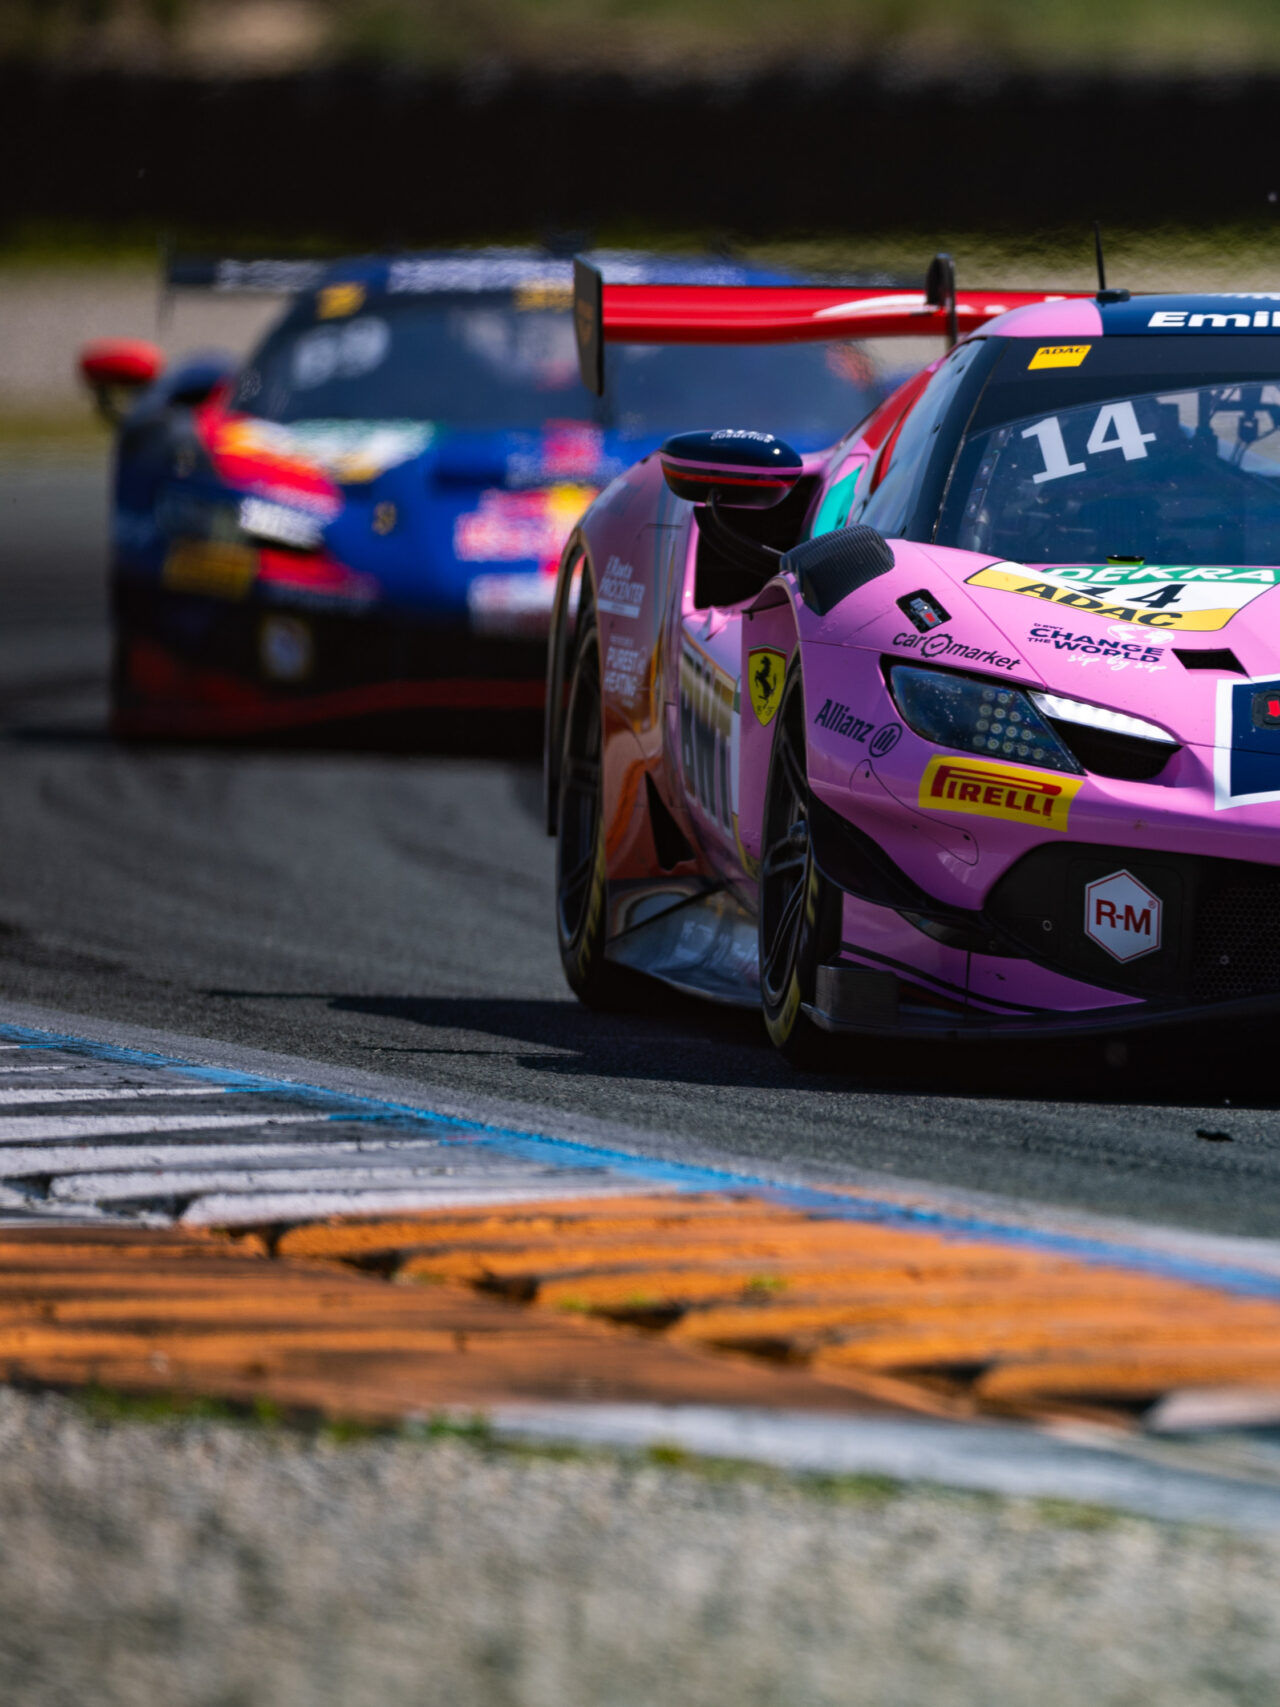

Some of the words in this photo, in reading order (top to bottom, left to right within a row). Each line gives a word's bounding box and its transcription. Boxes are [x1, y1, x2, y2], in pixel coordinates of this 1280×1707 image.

[1039, 346, 1086, 356] ADAC
[1021, 401, 1157, 484] 14
[1048, 565, 1276, 583] DEKRA
[1014, 583, 1183, 627] ADAC
[1030, 628, 1165, 656] CHANGE
[1054, 640, 1160, 663] WORLD
[814, 699, 875, 744] Allianz
[930, 765, 1062, 817] PIRELLI
[1095, 898, 1151, 936] R-M
